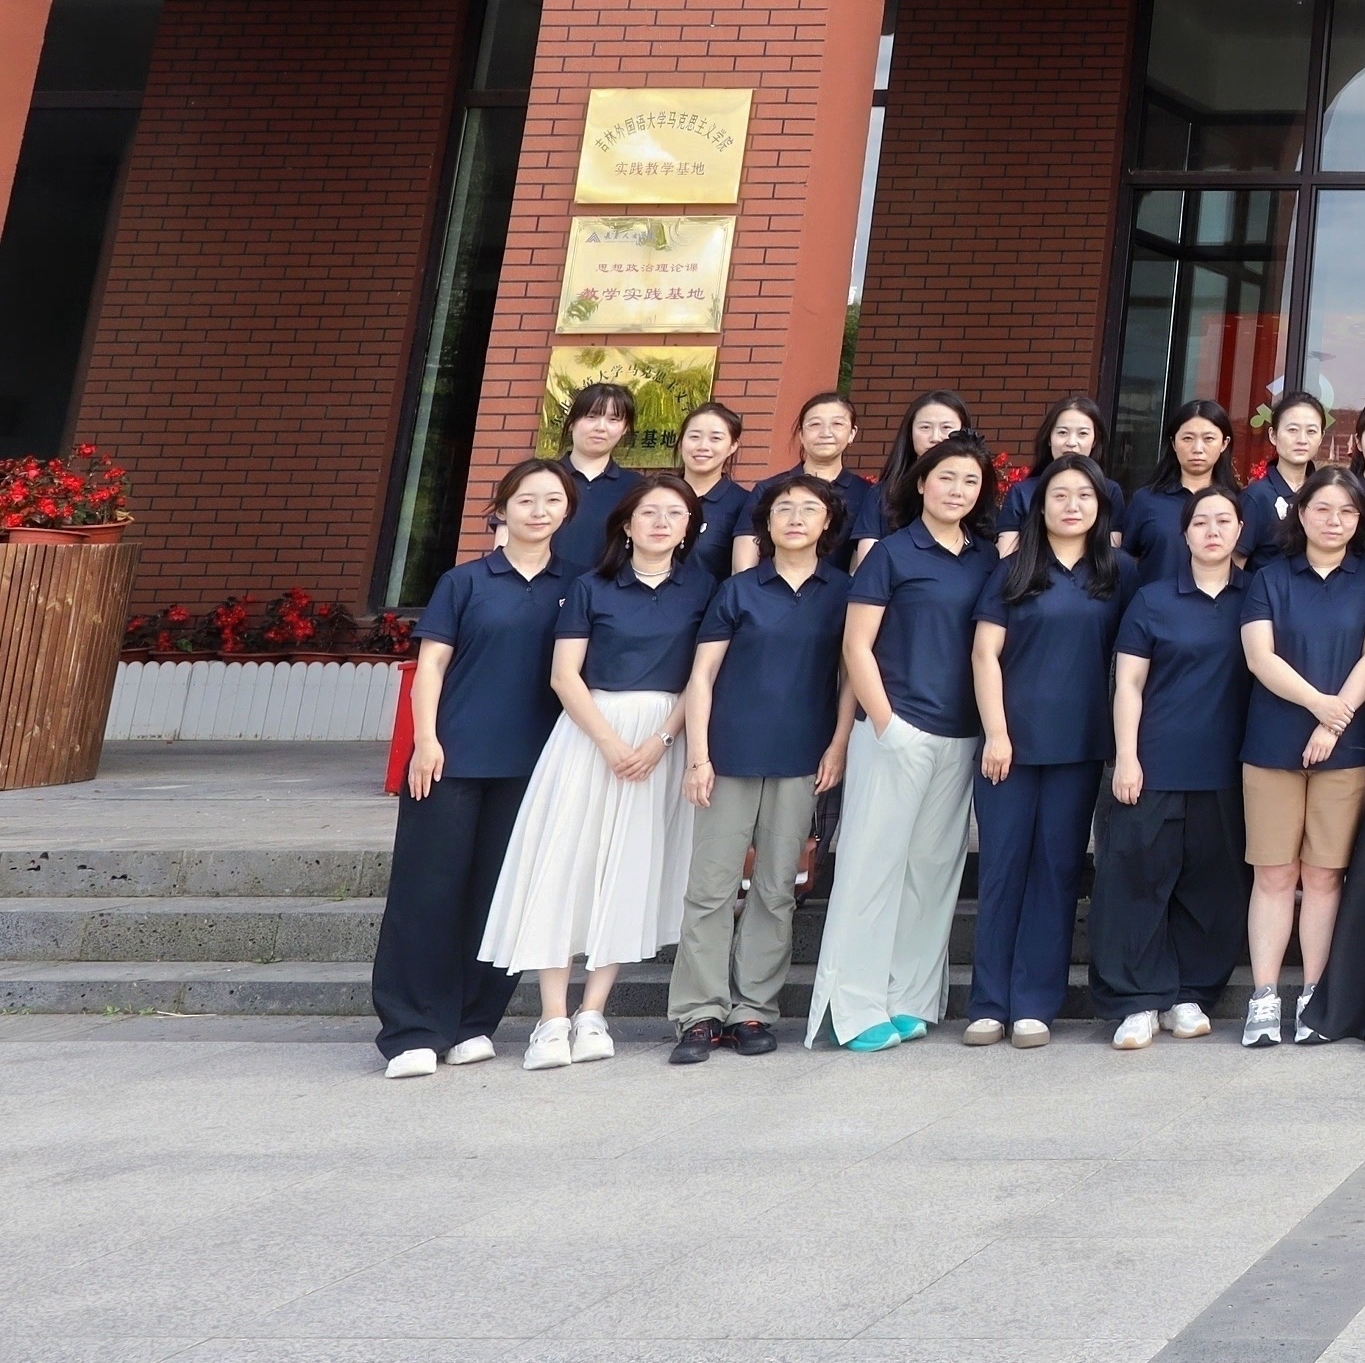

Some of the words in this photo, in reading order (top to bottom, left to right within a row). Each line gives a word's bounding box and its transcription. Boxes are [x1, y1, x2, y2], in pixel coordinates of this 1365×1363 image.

[594, 110, 734, 152] 吉林外国语大学马克思主义学院
[614, 161, 705, 176] 实践教学基地
[595, 263, 699, 273] 思想政治理论课
[580, 287, 706, 301] 教学实践基地
